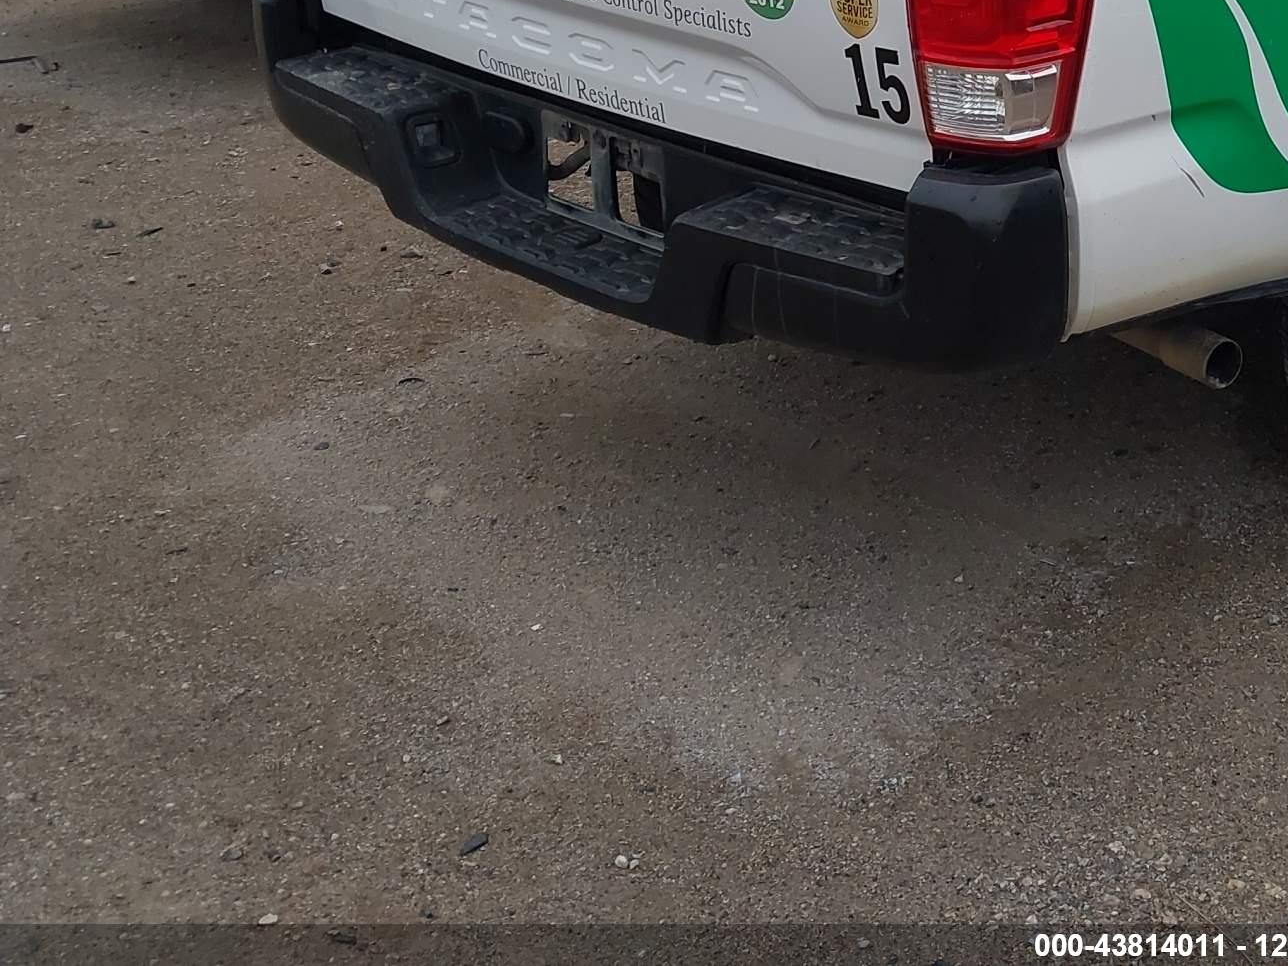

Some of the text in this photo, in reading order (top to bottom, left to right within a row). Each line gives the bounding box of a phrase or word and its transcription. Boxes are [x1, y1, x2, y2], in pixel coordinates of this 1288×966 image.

[664, 0, 752, 38] Specialists
[837, 1, 873, 19] SERVICE
[842, 16, 870, 27] AWARD
[478, 48, 563, 95] Commercial
[577, 77, 667, 125] Residential
[844, 43, 911, 125] 15
